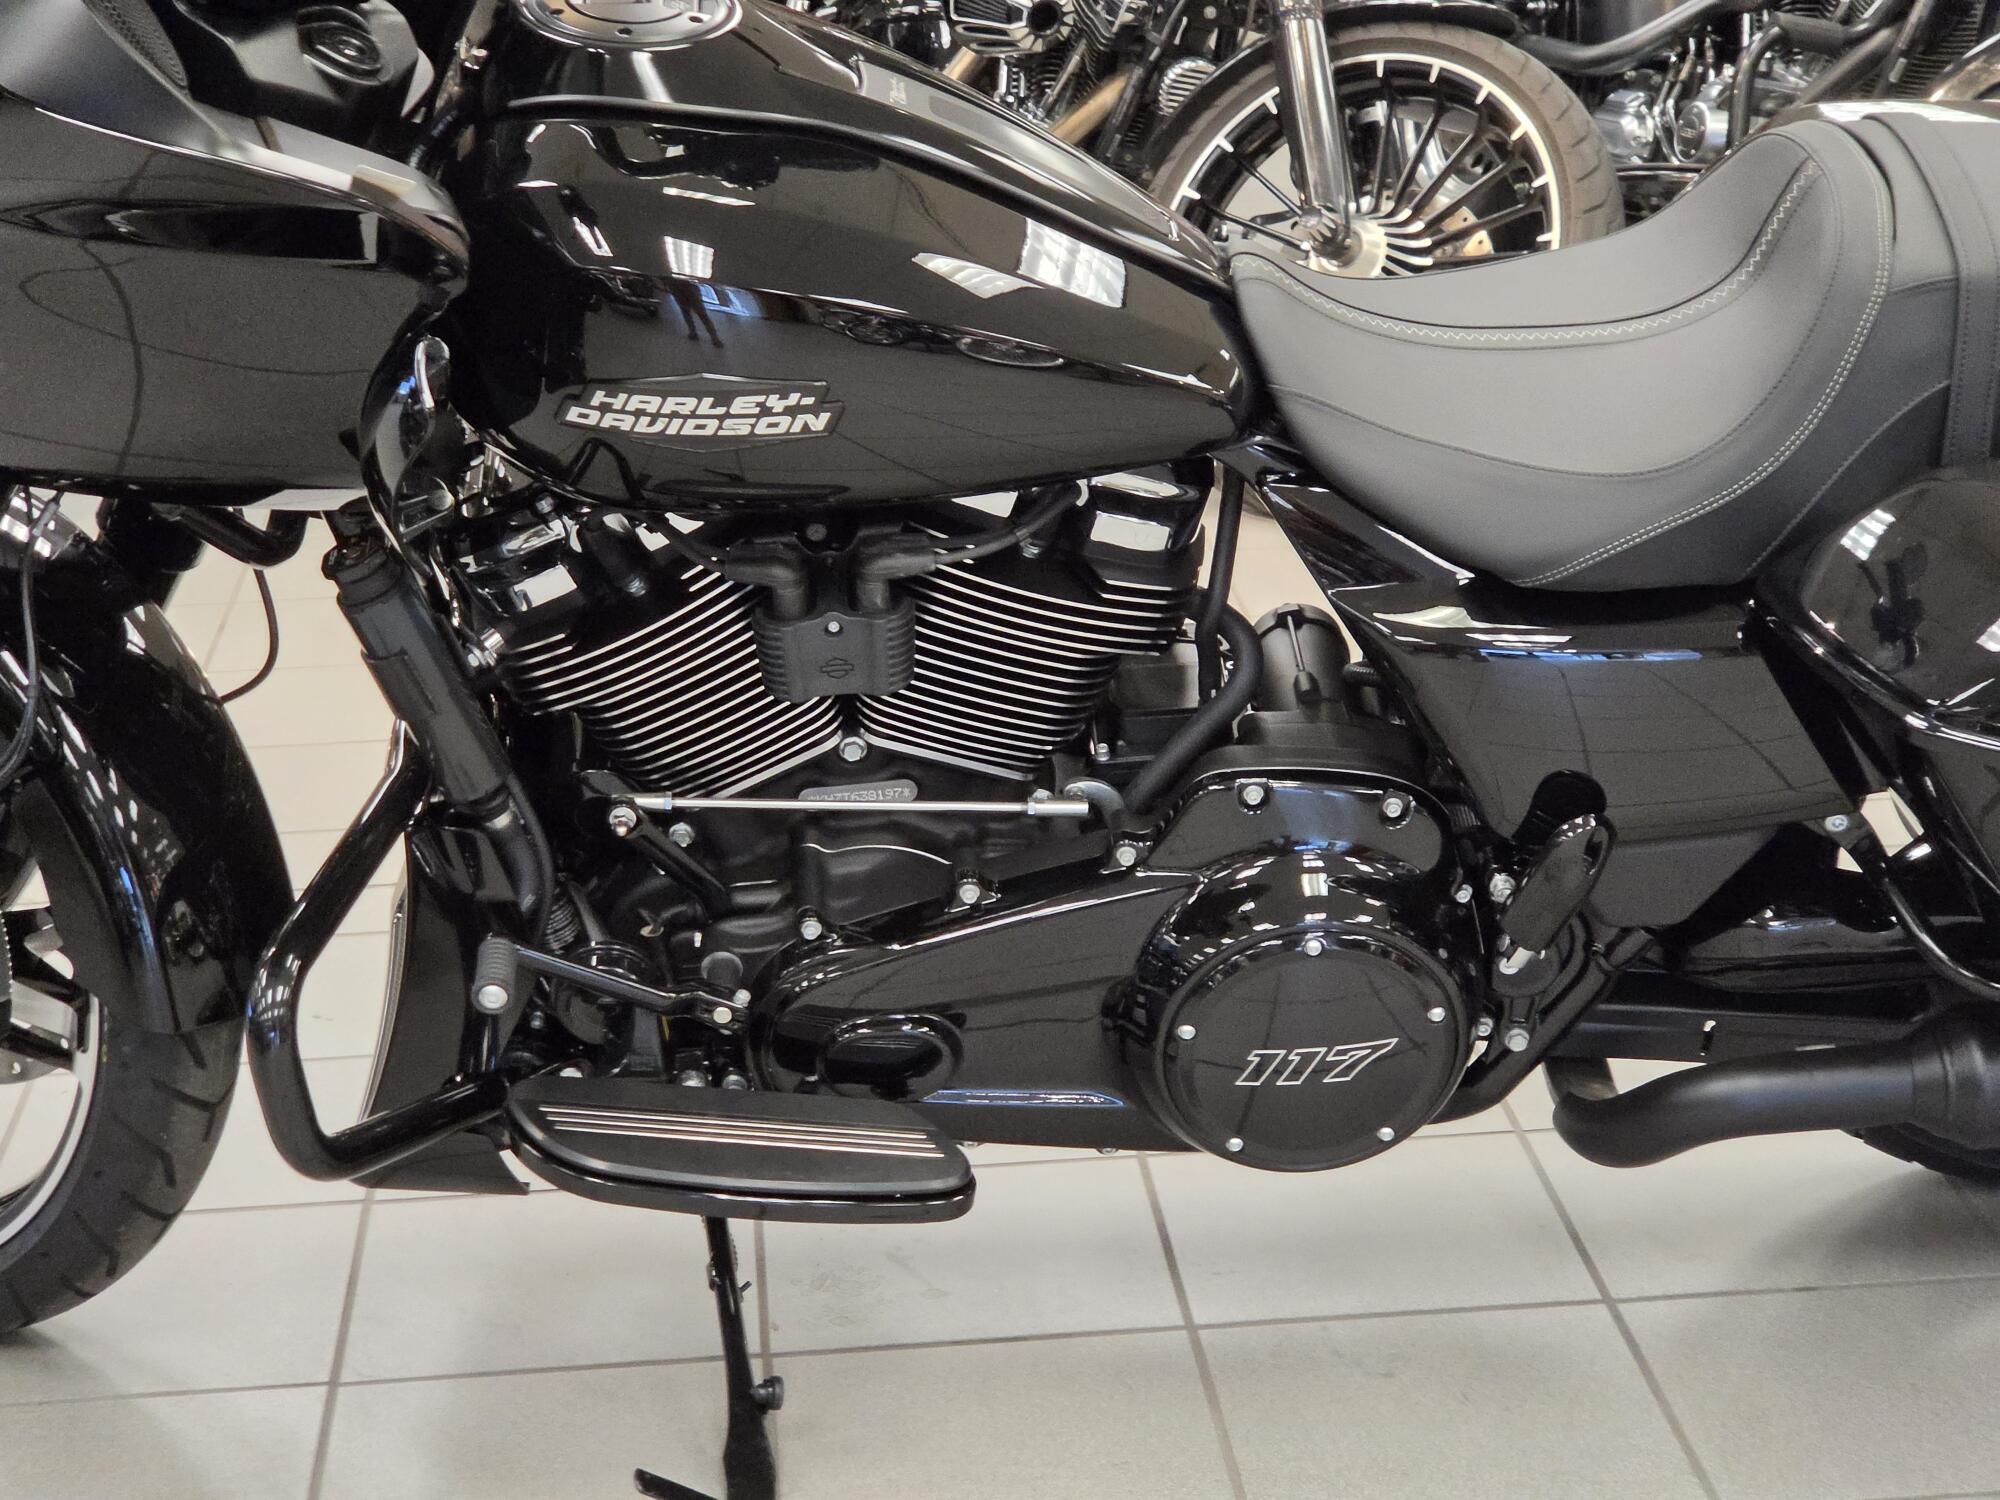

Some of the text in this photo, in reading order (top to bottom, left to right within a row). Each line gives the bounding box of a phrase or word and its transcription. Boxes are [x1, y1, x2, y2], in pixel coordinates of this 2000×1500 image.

[590, 390, 816, 416] HARLEY-
[565, 405, 832, 436] DAVIDSON
[1235, 1037, 1399, 1086] 117
